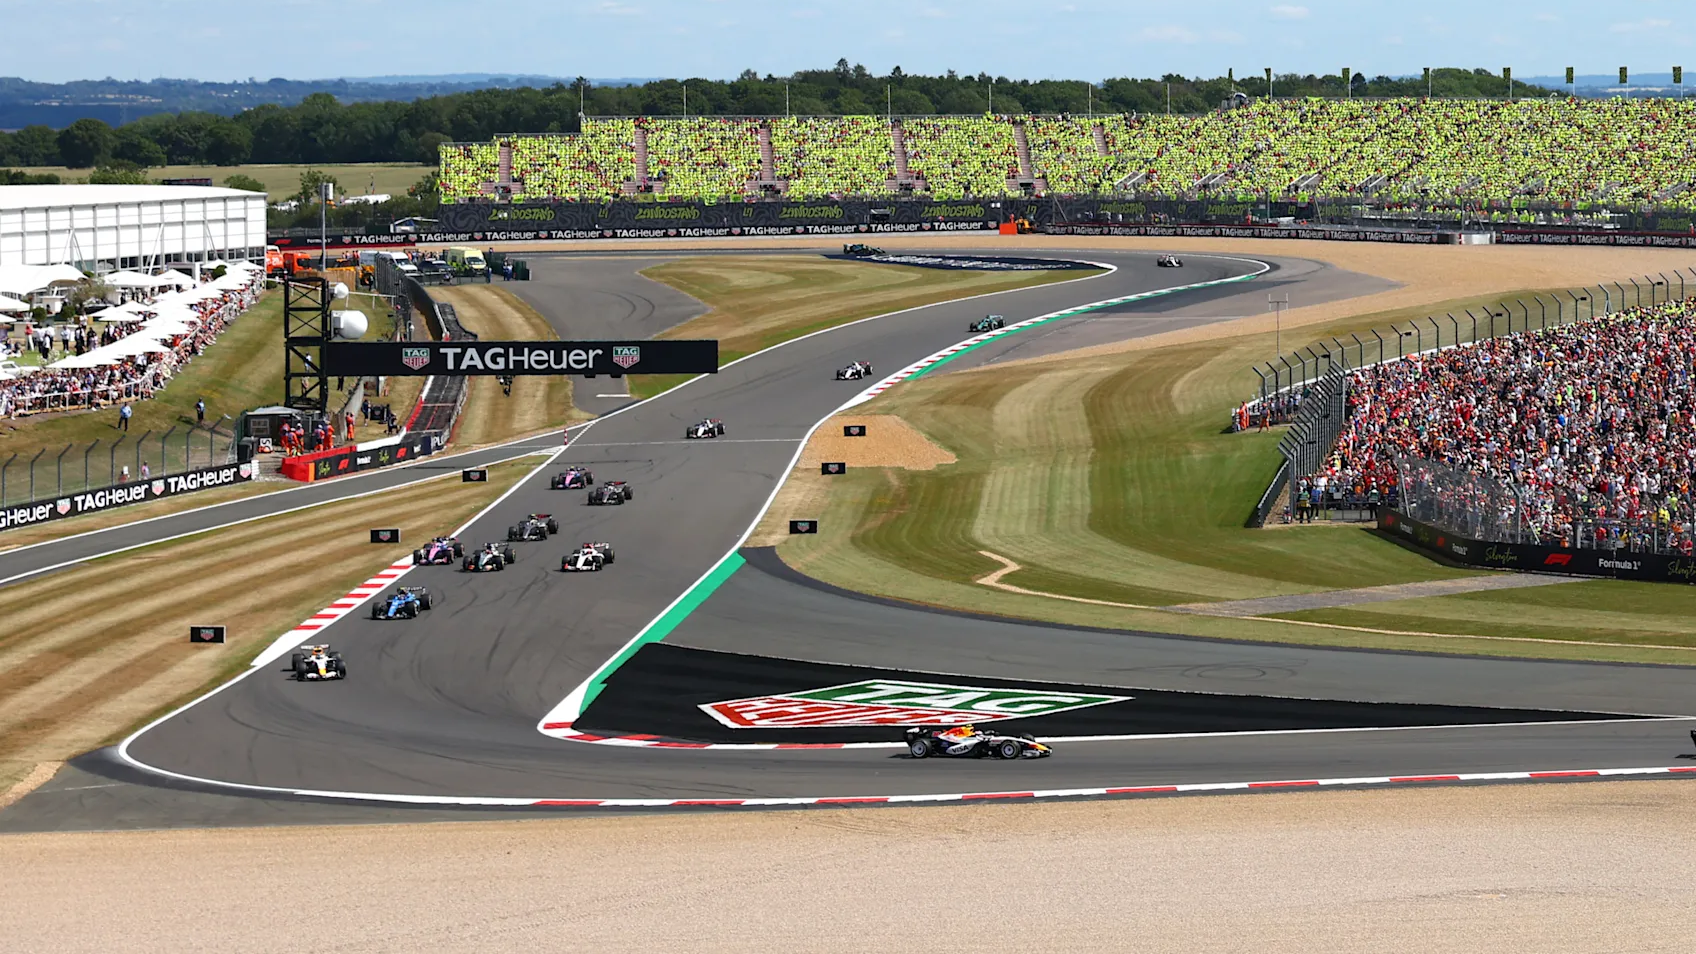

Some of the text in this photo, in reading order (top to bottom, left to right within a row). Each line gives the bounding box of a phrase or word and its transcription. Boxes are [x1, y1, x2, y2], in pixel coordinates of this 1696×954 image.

[743, 226, 794, 235] TAGHeuer
[806, 224, 856, 234] TAGHeuer
[870, 223, 920, 232] TAGHeuer
[934, 222, 983, 230] TAGHeuer
[486, 230, 536, 240] TAGHeuer
[550, 230, 600, 238] TAGHeuer
[615, 228, 666, 238] TAGHeuer
[678, 227, 730, 236] TAGHeuer
[354, 234, 406, 243] TAGHeuer
[420, 232, 470, 242] TAGHeuer
[440, 348, 603, 370] TAGHeuer
[168, 467, 237, 493] TAGHeuer
[74, 484, 149, 512] TAGHeuer
[840, 684, 1085, 712] TAG
[952, 746, 969, 754] VISA
